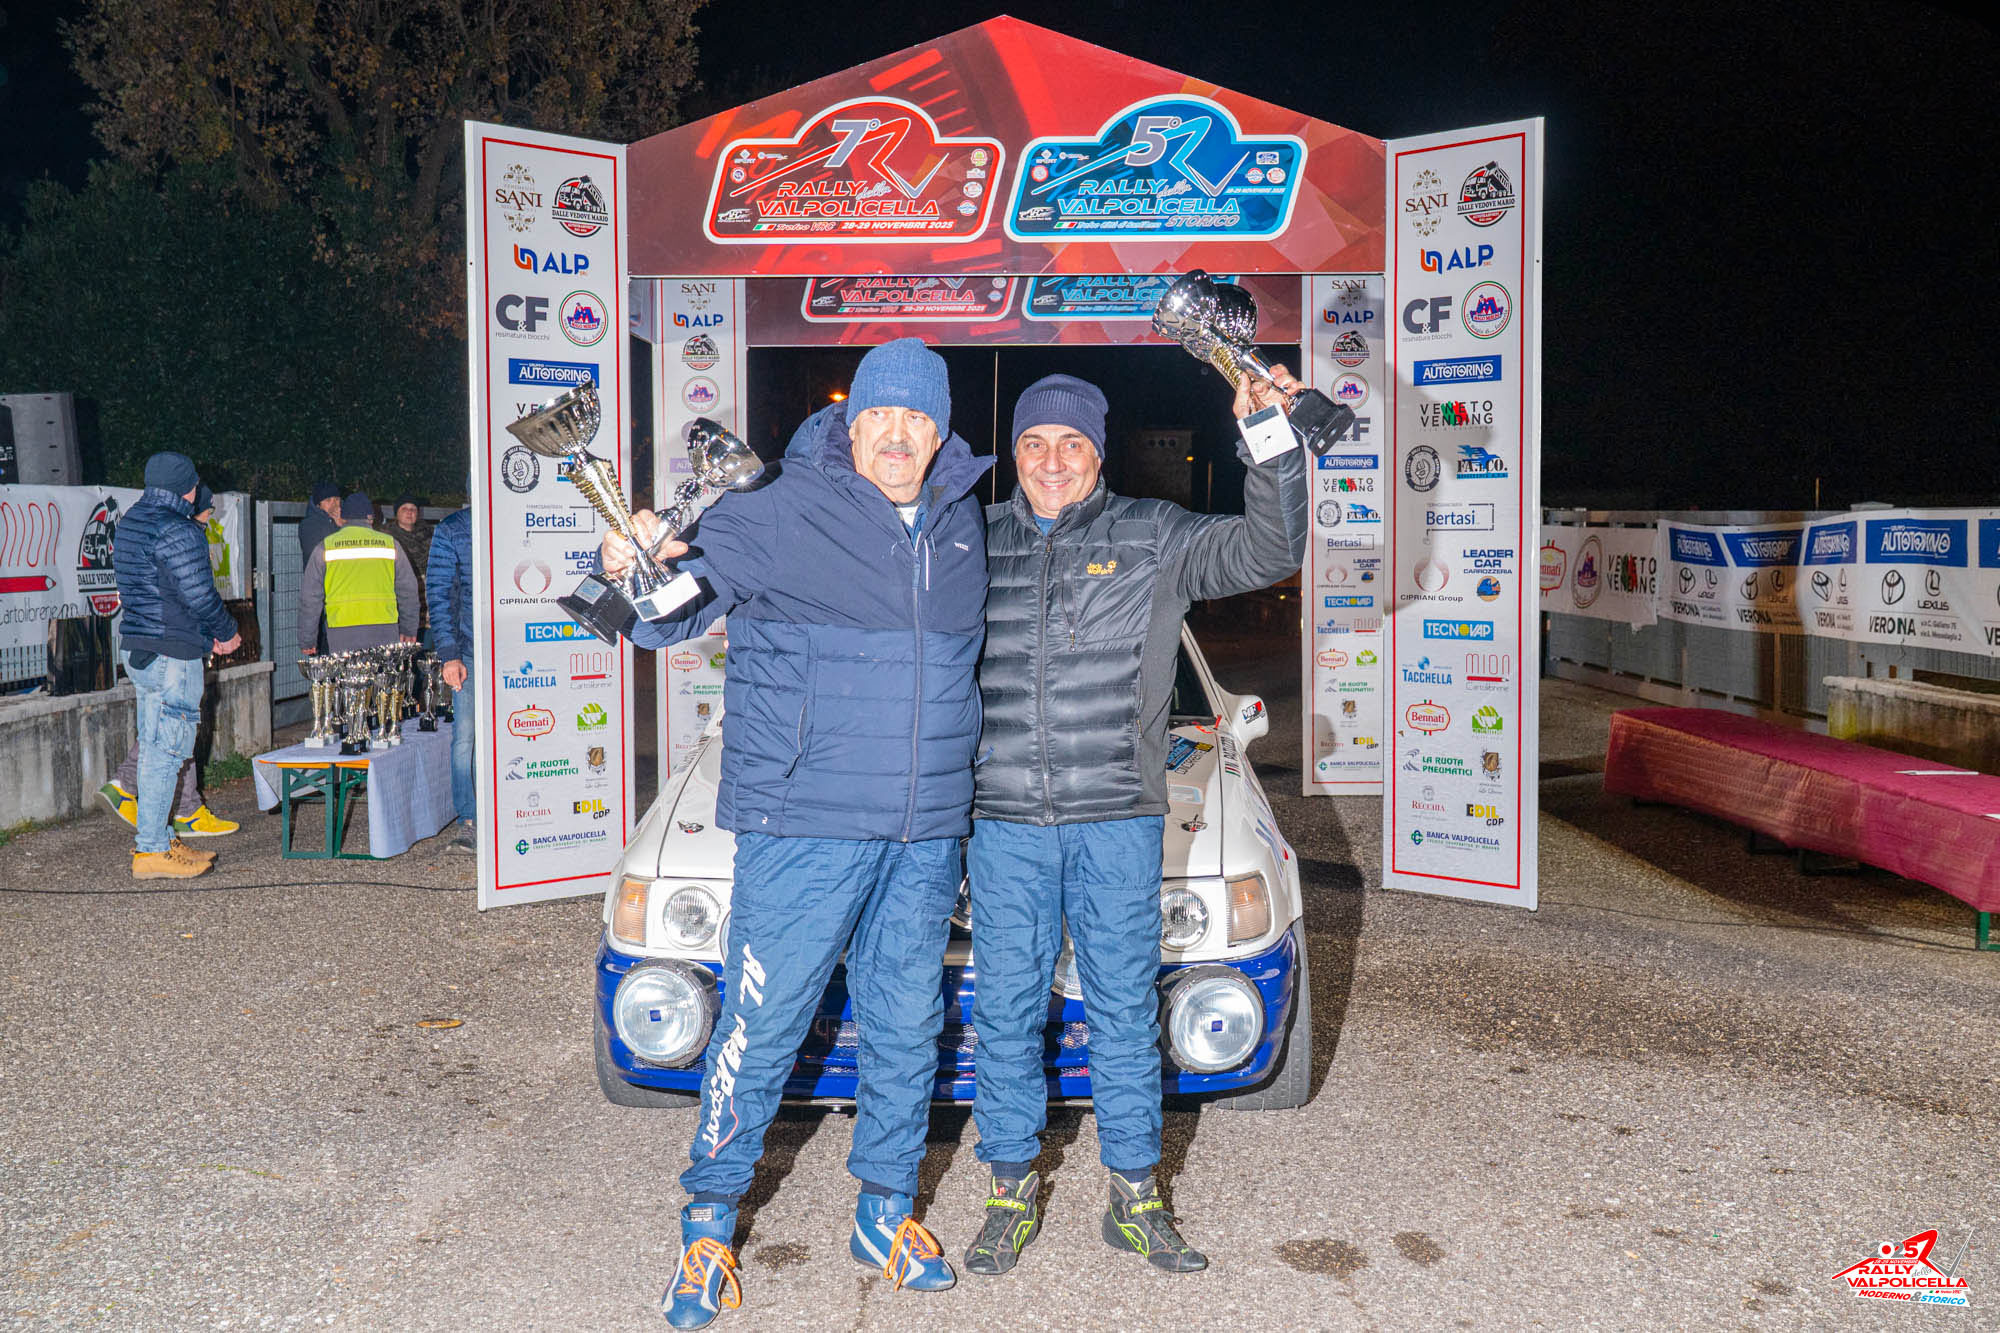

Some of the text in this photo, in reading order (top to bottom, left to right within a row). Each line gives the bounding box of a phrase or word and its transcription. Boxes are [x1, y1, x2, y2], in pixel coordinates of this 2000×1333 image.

[778, 180, 892, 201] RALLY della
[1078, 180, 1193, 199] RALLY della
[496, 188, 543, 211] SANI
[1058, 198, 1241, 215] VALPOLICELLA
[1406, 193, 1449, 215] SANI
[1458, 198, 1515, 212] DALLE VEDOVE MARIO
[756, 200, 940, 217] VALPOLICELLA
[552, 210, 608, 222] DALLE VEDOVE MARIO
[1165, 215, 1241, 227] STORICO
[542, 252, 590, 274] ALP
[1447, 244, 1494, 271] ALP
[856, 278, 920, 288] RALLY
[1076, 276, 1140, 287] RALLY
[1332, 280, 1366, 293] SANI
[681, 283, 717, 296] SANI
[840, 290, 974, 303] VALPOLICELLA
[496, 294, 550, 332] C&F
[1342, 310, 1374, 324] ALP
[1403, 296, 1453, 334] C&F
[692, 314, 724, 327] ALP
[519, 366, 591, 382] AUTOTORINO
[1423, 363, 1493, 380] AUTOTORINO
[1420, 400, 1493, 415] VENETO
[1420, 413, 1493, 427] VENDING
[526, 512, 576, 528] Bertasi
[1426, 510, 1475, 526] Bertasi
[335, 540, 362, 548] UFFICIALE
[1327, 538, 1362, 548] Bertasi
[1881, 532, 1951, 554] AUTOTORINO
[565, 552, 597, 560] LEAD
[1463, 549, 1514, 558] LEADER
[576, 561, 594, 569] CA
[1474, 559, 1502, 568] CAR
[78, 573, 116, 585] DALLE VEDOV
[1438, 595, 1464, 603] Group
[1917, 600, 1950, 611] LEXUS
[1737, 608, 1773, 624] VERONA
[1426, 622, 1491, 638] TECNOVAP
[1869, 615, 1916, 636] VERONA
[503, 676, 557, 689] TACCHELLA
[1402, 669, 1452, 685] TACCHELLA
[514, 717, 549, 728] Bennati
[1412, 711, 1445, 725] Bennati
[540, 759, 569, 768] RUOTA
[1422, 756, 1464, 766] LA RUOTA
[527, 768, 579, 779] PNEUMATICI
[1422, 765, 1473, 776] PNEUMATICI
[574, 799, 606, 814] EDIL
[1466, 804, 1499, 818] EDIL
[593, 809, 610, 820] CDP
[1486, 818, 1504, 826] CDP
[533, 830, 606, 845] BANCA VALPOLICELLA
[1426, 831, 1500, 846] BANCA VALPOLICELLA
